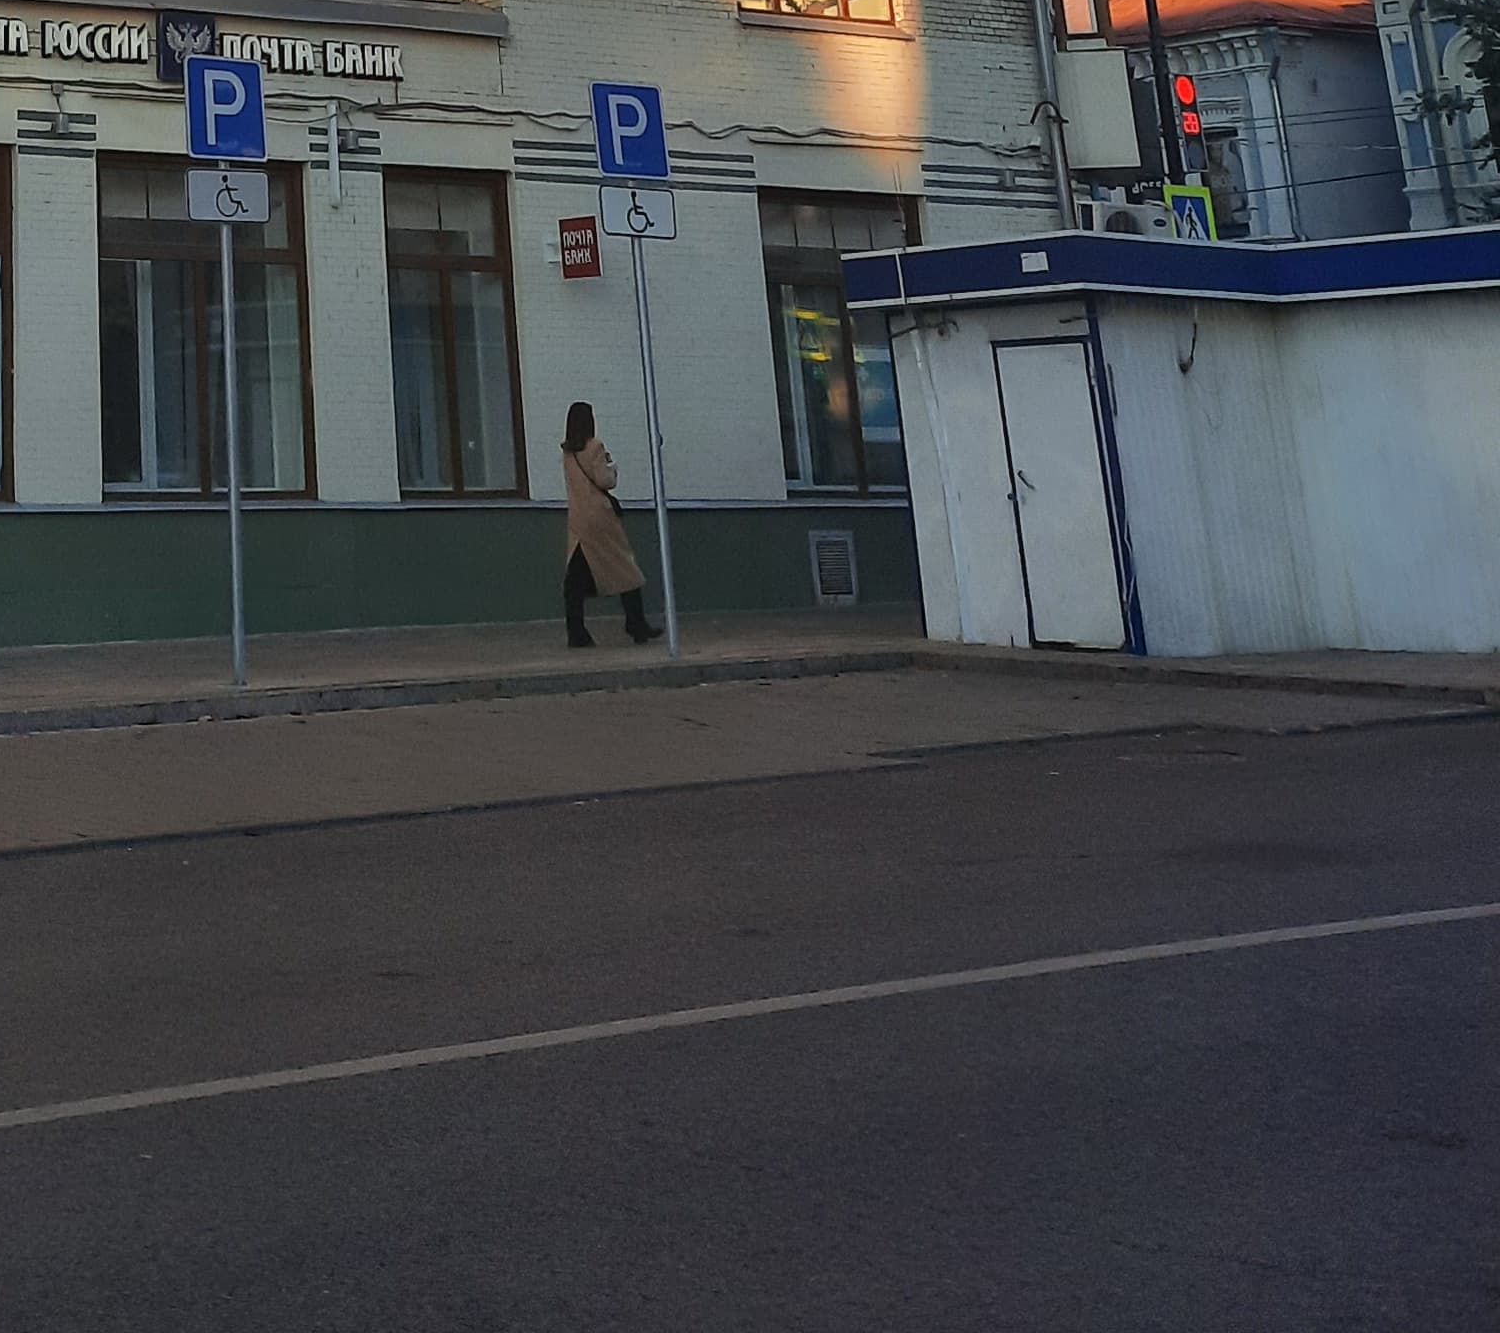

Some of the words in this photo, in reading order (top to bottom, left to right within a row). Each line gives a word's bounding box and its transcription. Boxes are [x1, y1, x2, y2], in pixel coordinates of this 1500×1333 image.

[41, 20, 150, 64] РОССИИ
[220, 33, 315, 75] ПОЧТА
[322, 40, 404, 81] БАНК
[203, 69, 247, 145] P
[607, 94, 648, 165] P
[562, 229, 595, 249] ПОЧТА
[564, 247, 593, 265] БАНК
